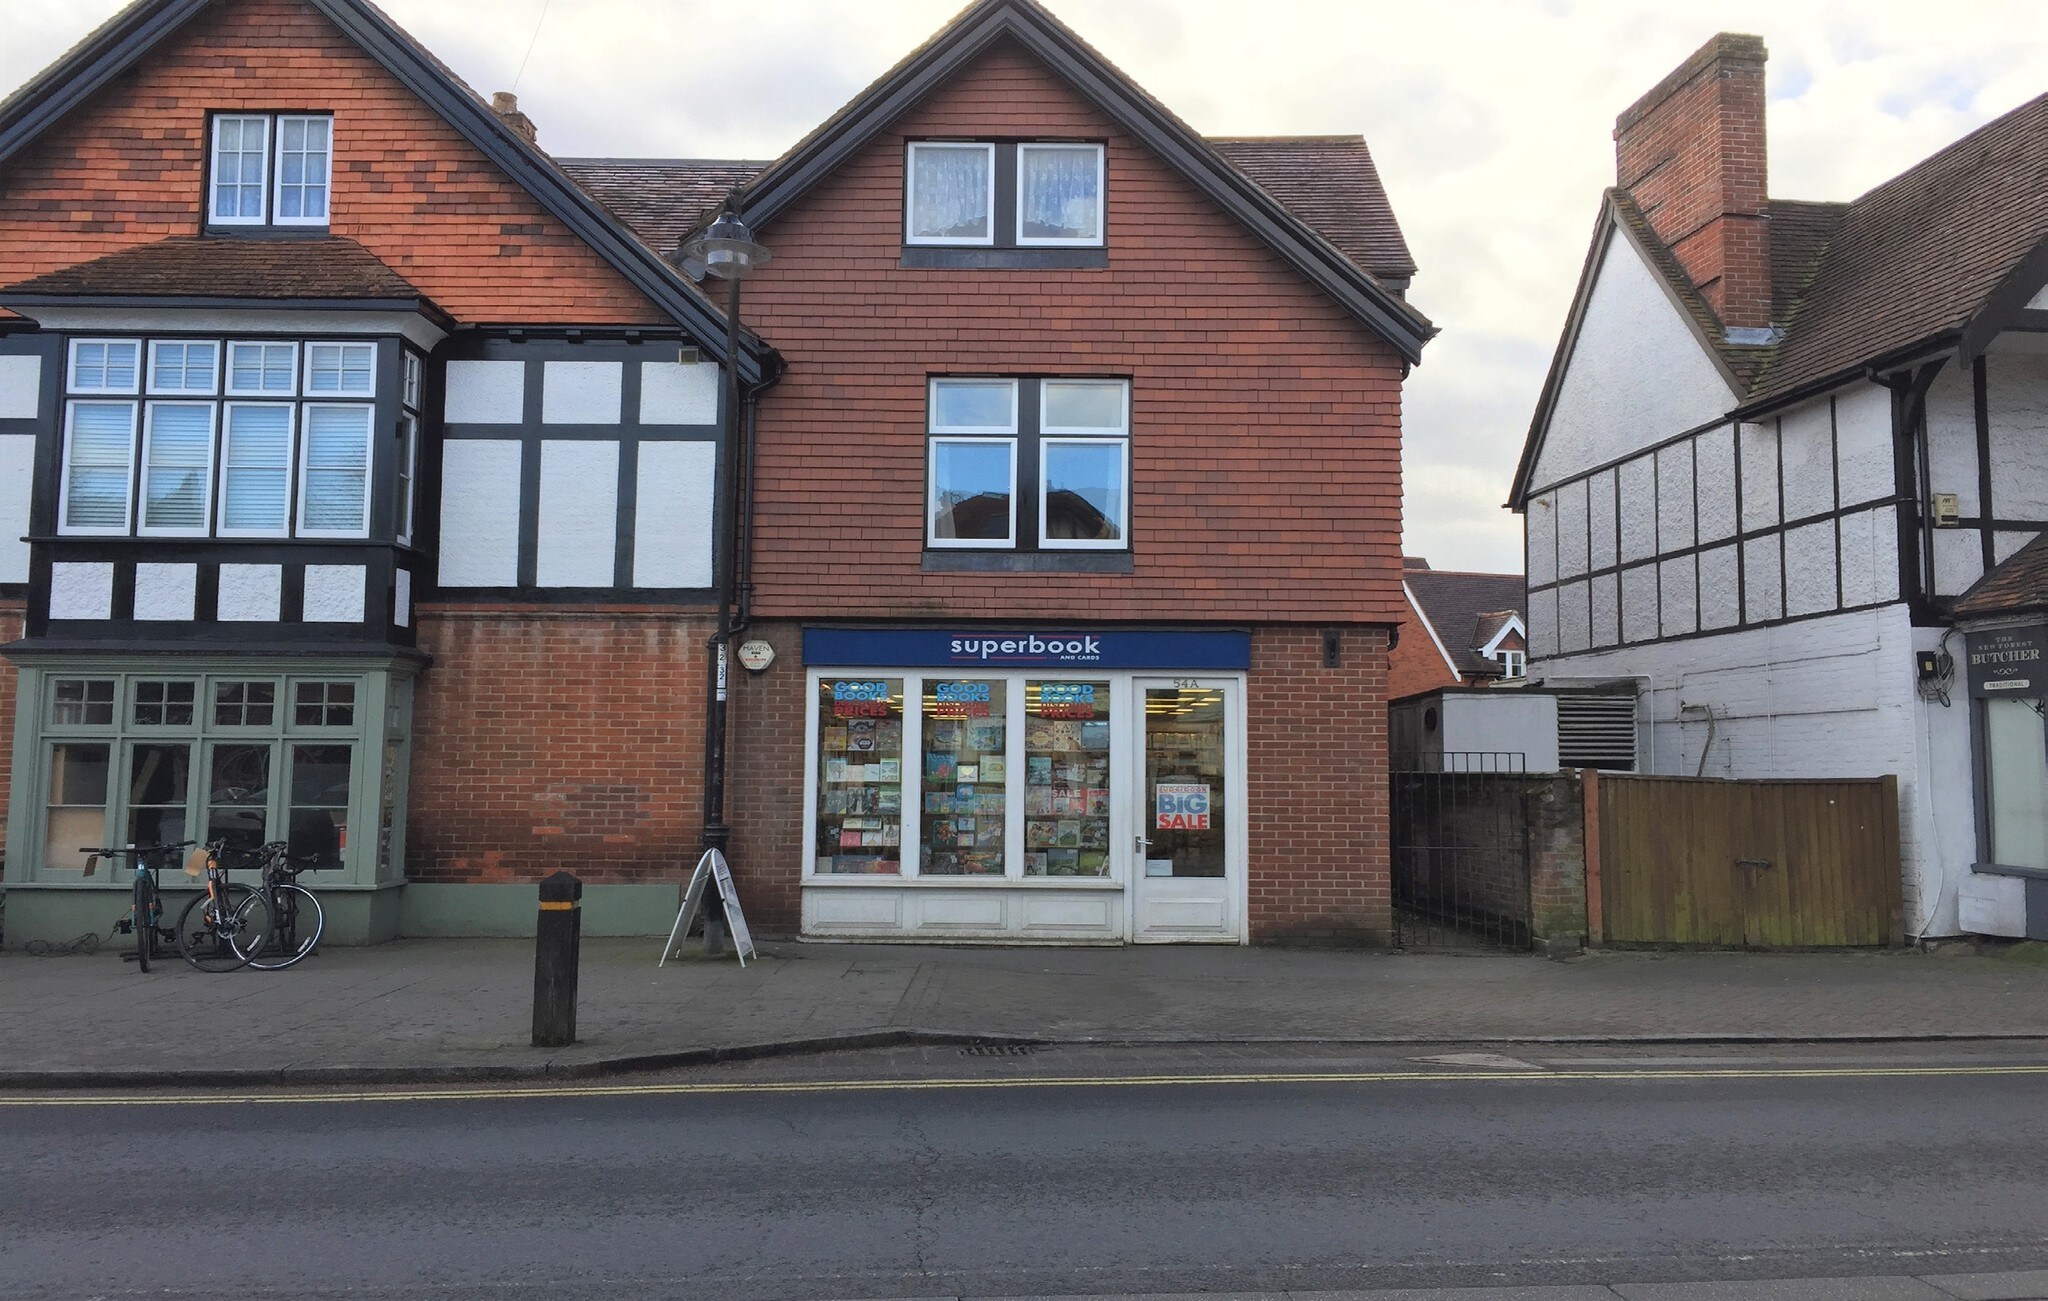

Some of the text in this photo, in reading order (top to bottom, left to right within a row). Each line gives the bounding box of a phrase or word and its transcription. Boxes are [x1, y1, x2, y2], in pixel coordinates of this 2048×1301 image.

[743, 644, 770, 652] HAVEN
[950, 634, 1101, 660] superbook
[1977, 640, 2033, 652] NEW FOREST
[1971, 648, 2041, 665] BUTCHER
[834, 681, 888, 692] GOOD
[936, 683, 990, 693] GOOD
[1173, 679, 1199, 689] 54A
[1988, 681, 2025, 689] TRADITIONAL
[1041, 684, 1095, 695] GOOD
[833, 692, 888, 701] BOOKS
[936, 692, 990, 702] BOOKS
[1041, 694, 1095, 703] BOOKS
[833, 705, 888, 716] PRICES
[936, 707, 990, 718] PRICES
[1040, 707, 1095, 718] PRICES
[1055, 722, 1081, 731] CATS
[1051, 789, 1082, 798] SALE
[1158, 813, 1208, 829] SALE
